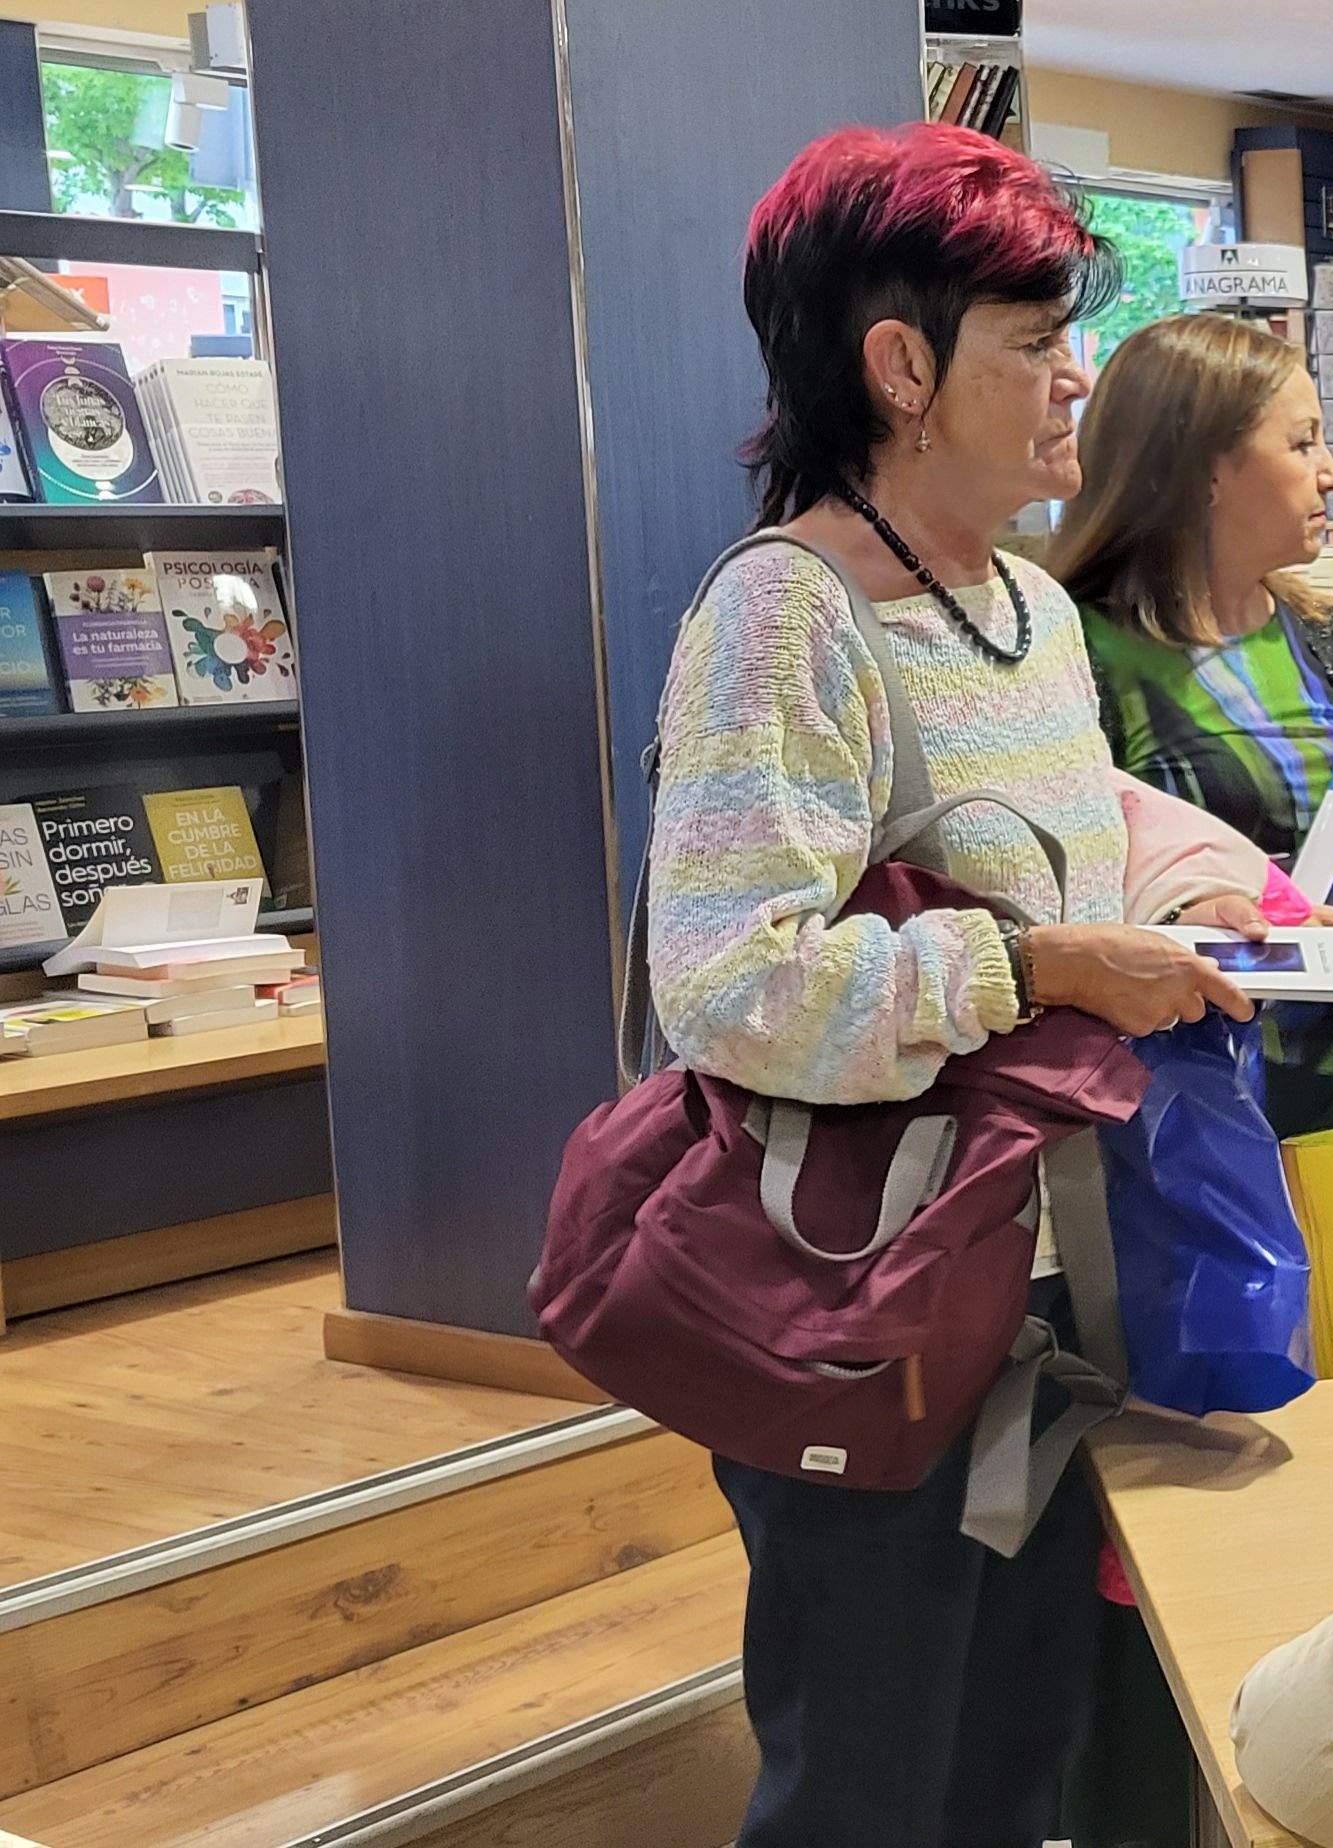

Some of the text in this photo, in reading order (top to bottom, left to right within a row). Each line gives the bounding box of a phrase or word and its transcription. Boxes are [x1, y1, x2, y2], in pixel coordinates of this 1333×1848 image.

[1185, 276, 1289, 295] ANAGRAMA
[205, 380, 249, 394] CÓMO
[163, 559, 264, 575] PSICOLOGÍA
[72, 628, 159, 643] La naturaleza
[73, 640, 163, 656] es tu farmacia
[176, 808, 226, 826] EN LA
[41, 812, 134, 842] Primero
[168, 823, 243, 845] CUMBRE
[49, 837, 132, 864] dormir,
[185, 841, 235, 860] DE LA
[55, 855, 152, 886] después
[168, 855, 257, 879] FELICIDAD
